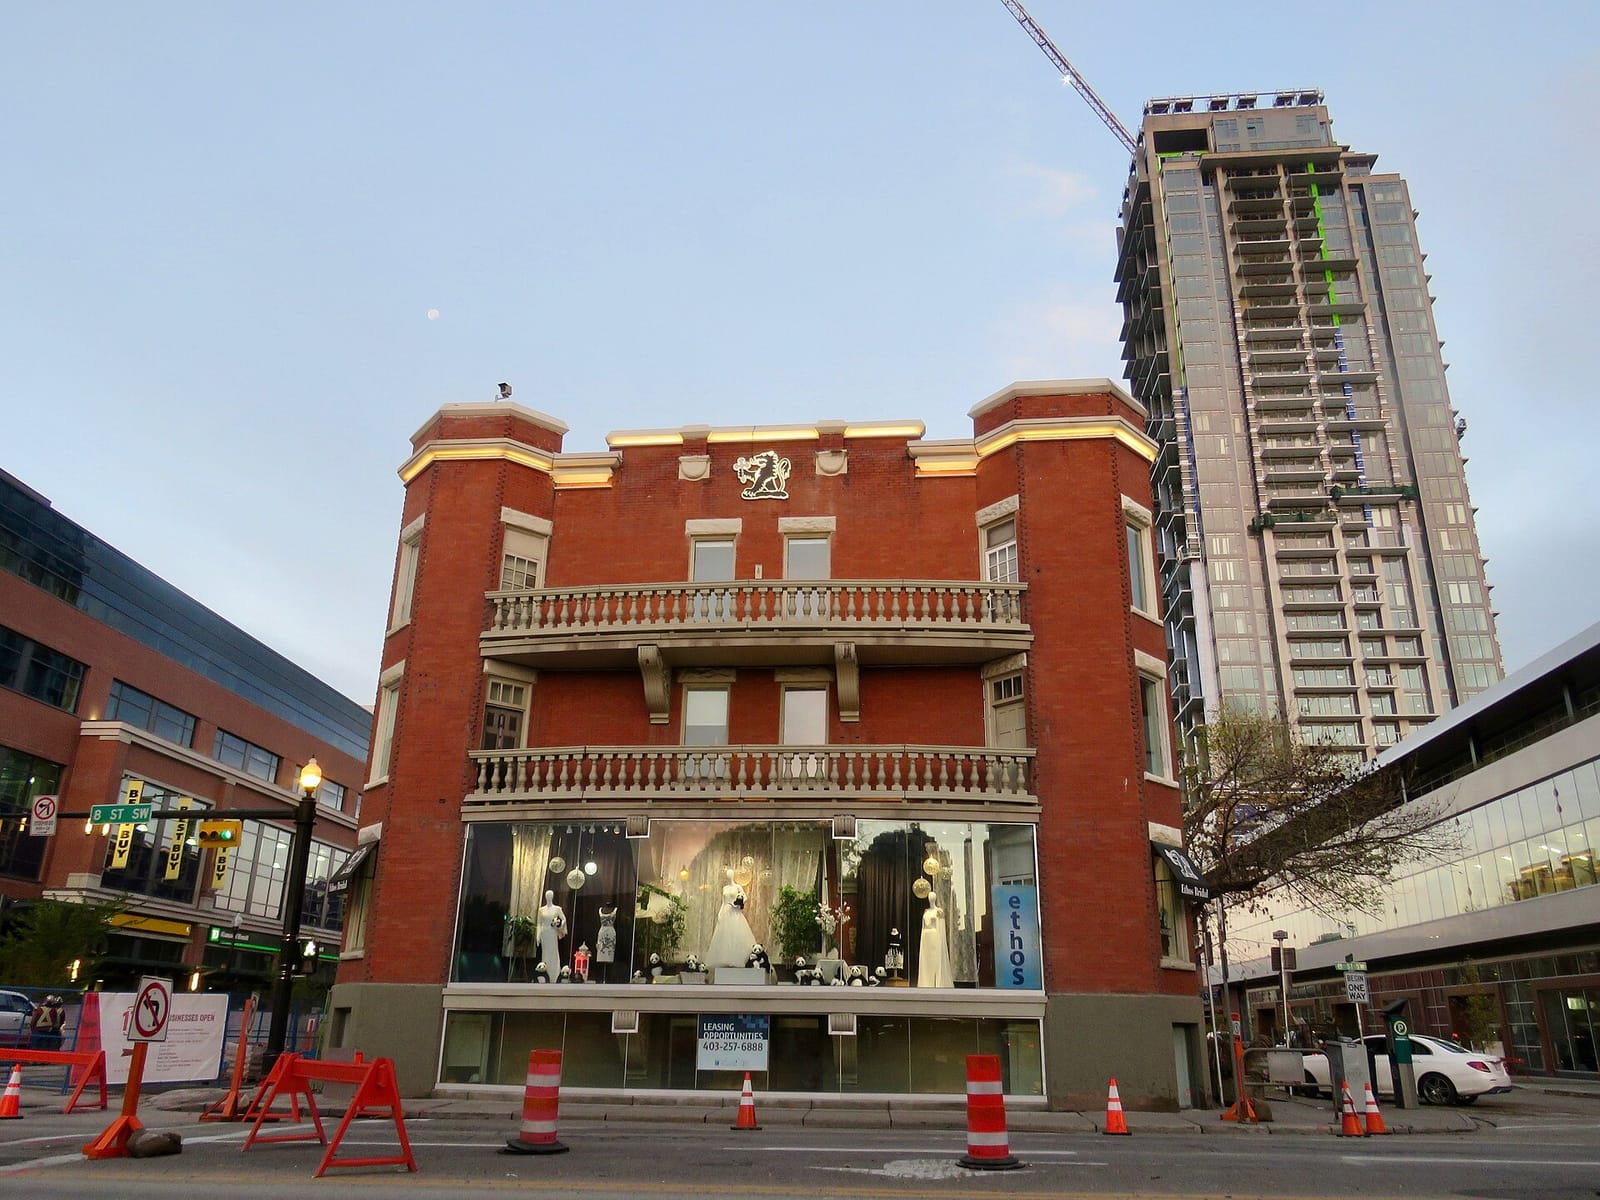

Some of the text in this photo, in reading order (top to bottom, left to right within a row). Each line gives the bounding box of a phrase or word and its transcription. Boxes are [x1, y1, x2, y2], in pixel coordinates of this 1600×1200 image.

[93, 807, 150, 821] 8 ST SW
[117, 831, 130, 858] BUY
[170, 845, 180, 871] BUY
[215, 856, 226, 881] BUY
[1008, 895, 1025, 985] ethos
[1348, 984, 1365, 992] ONE
[1349, 992, 1366, 1000] WAY
[170, 1013, 215, 1022] SINESSES OPEN
[703, 1022, 735, 1031] LEASING
[703, 1031, 764, 1040] OPPORTUNITIES
[702, 1041, 764, 1052] 403-257-6888
